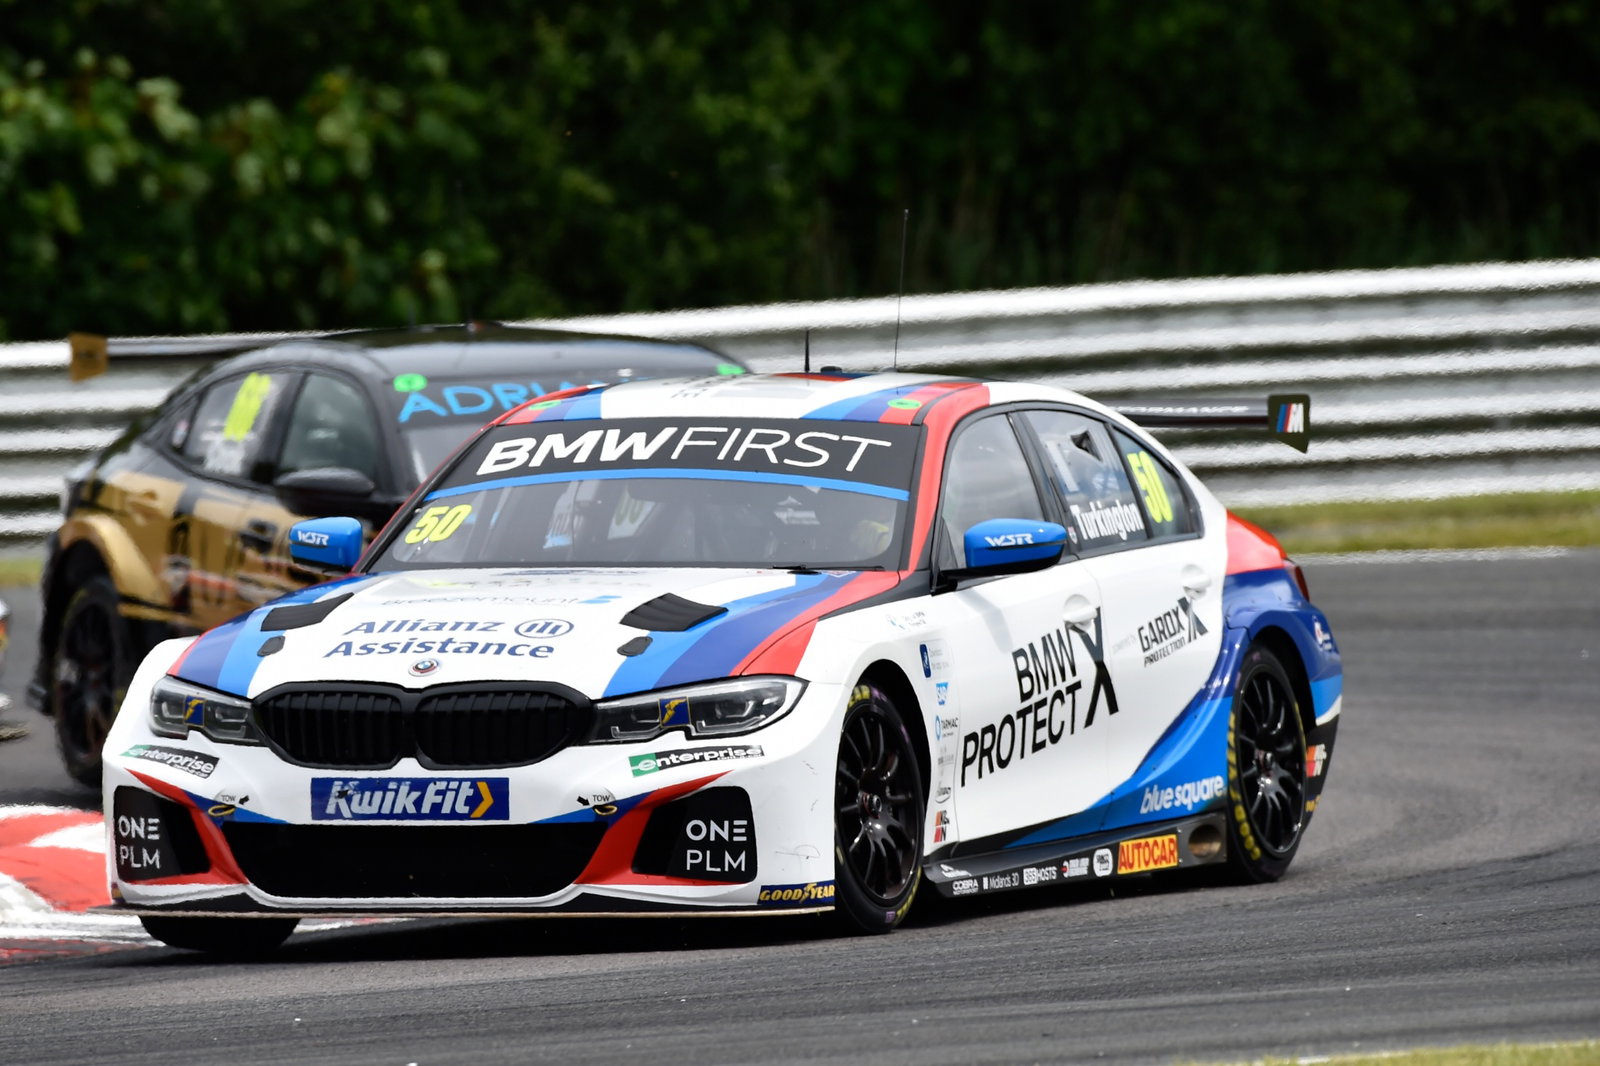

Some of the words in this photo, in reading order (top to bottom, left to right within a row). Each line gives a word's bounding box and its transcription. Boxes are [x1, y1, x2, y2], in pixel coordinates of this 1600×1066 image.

[1127, 450, 1174, 523] 50
[405, 504, 471, 544] 50
[1070, 500, 1144, 541] Turkington
[342, 619, 505, 636] Allianz
[322, 638, 555, 658] Assistance
[1012, 622, 1077, 704] BMW
[961, 680, 1082, 787] PROTECT
[127, 748, 215, 774] enterprise
[632, 747, 763, 771] enterprise
[1140, 784, 1174, 814] blue
[118, 815, 160, 840] ONE
[685, 819, 748, 842] ONE
[120, 844, 161, 869] PLM
[686, 850, 747, 872] PLM
[1119, 838, 1177, 870] AUTOCAR
[952, 879, 979, 891] COBRA
